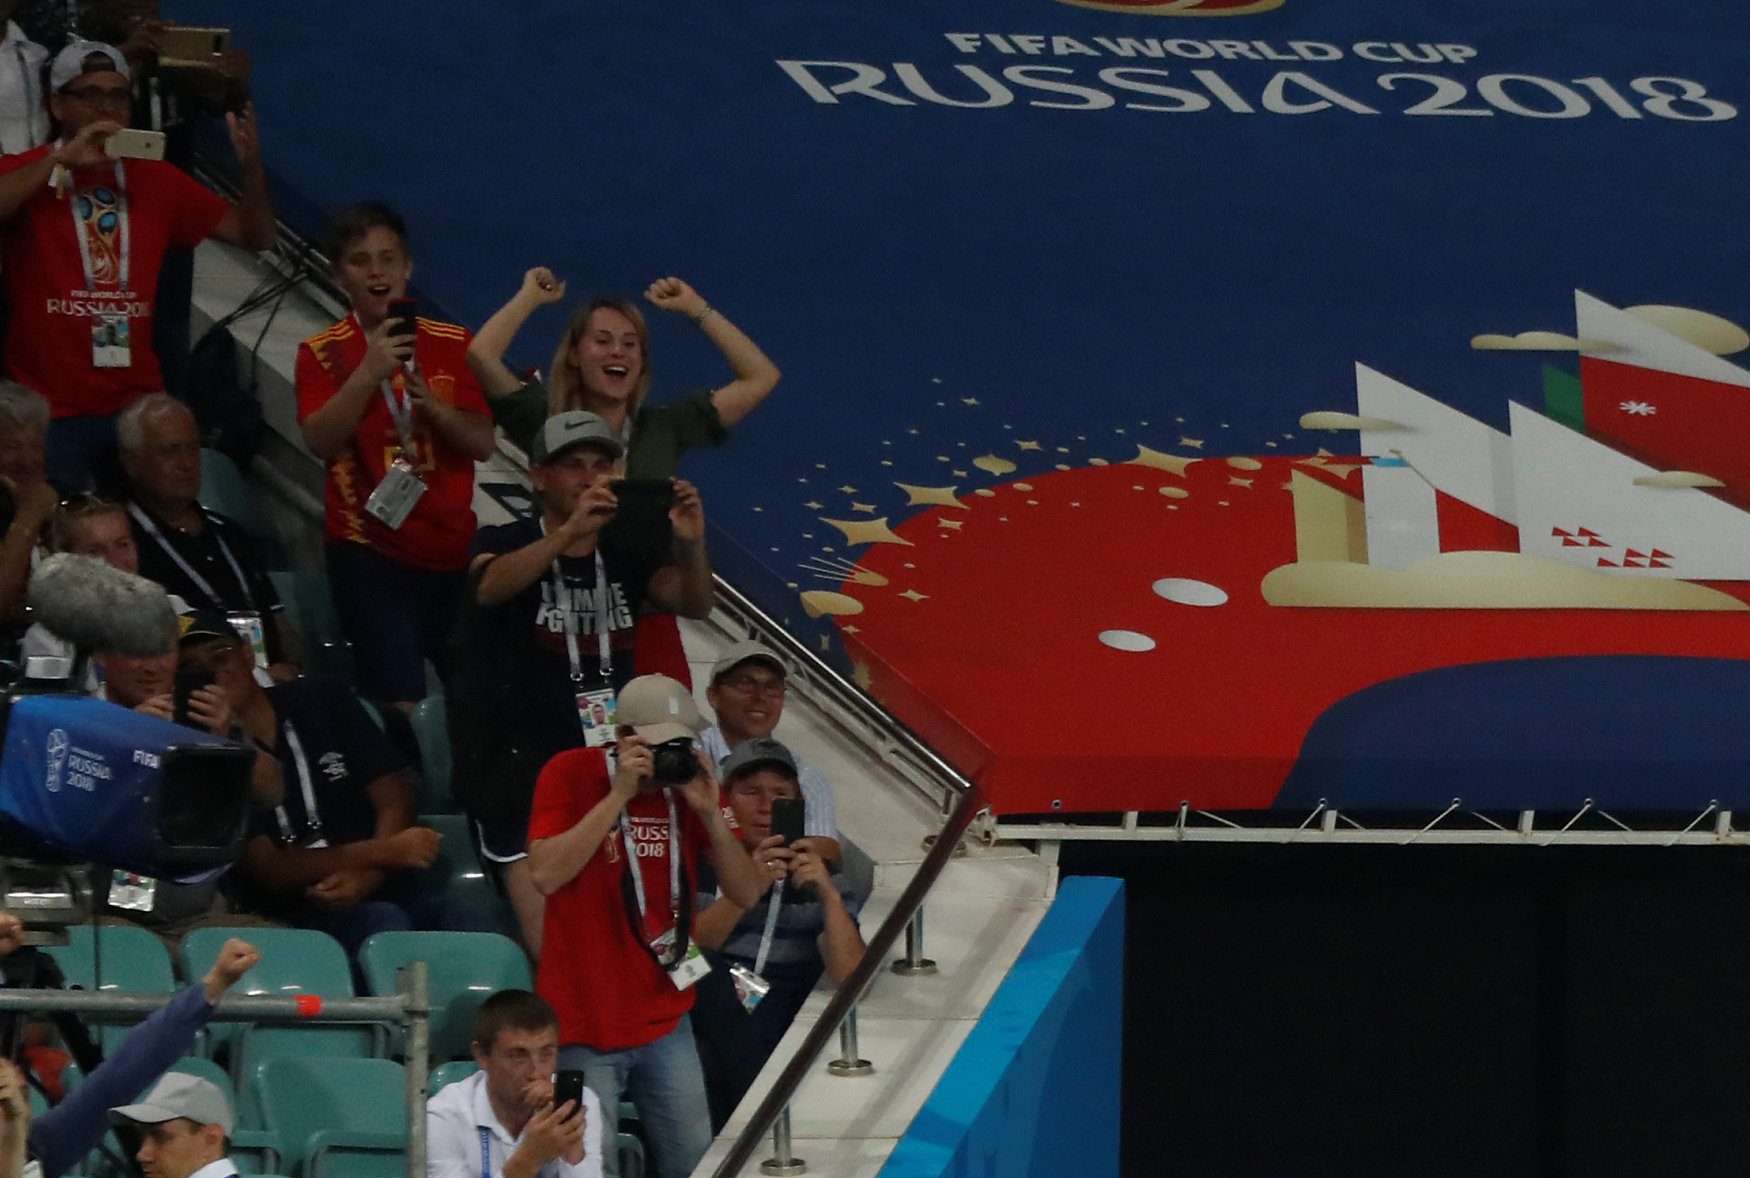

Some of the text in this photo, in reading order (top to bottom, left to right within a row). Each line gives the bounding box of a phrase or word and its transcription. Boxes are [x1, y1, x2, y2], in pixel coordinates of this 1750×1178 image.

[944, 33, 1477, 64] FIFA WORLD CUP
[775, 60, 1738, 121] RUSSIA 2018
[623, 824, 670, 841] RUSS
[634, 842, 665, 858] 018
